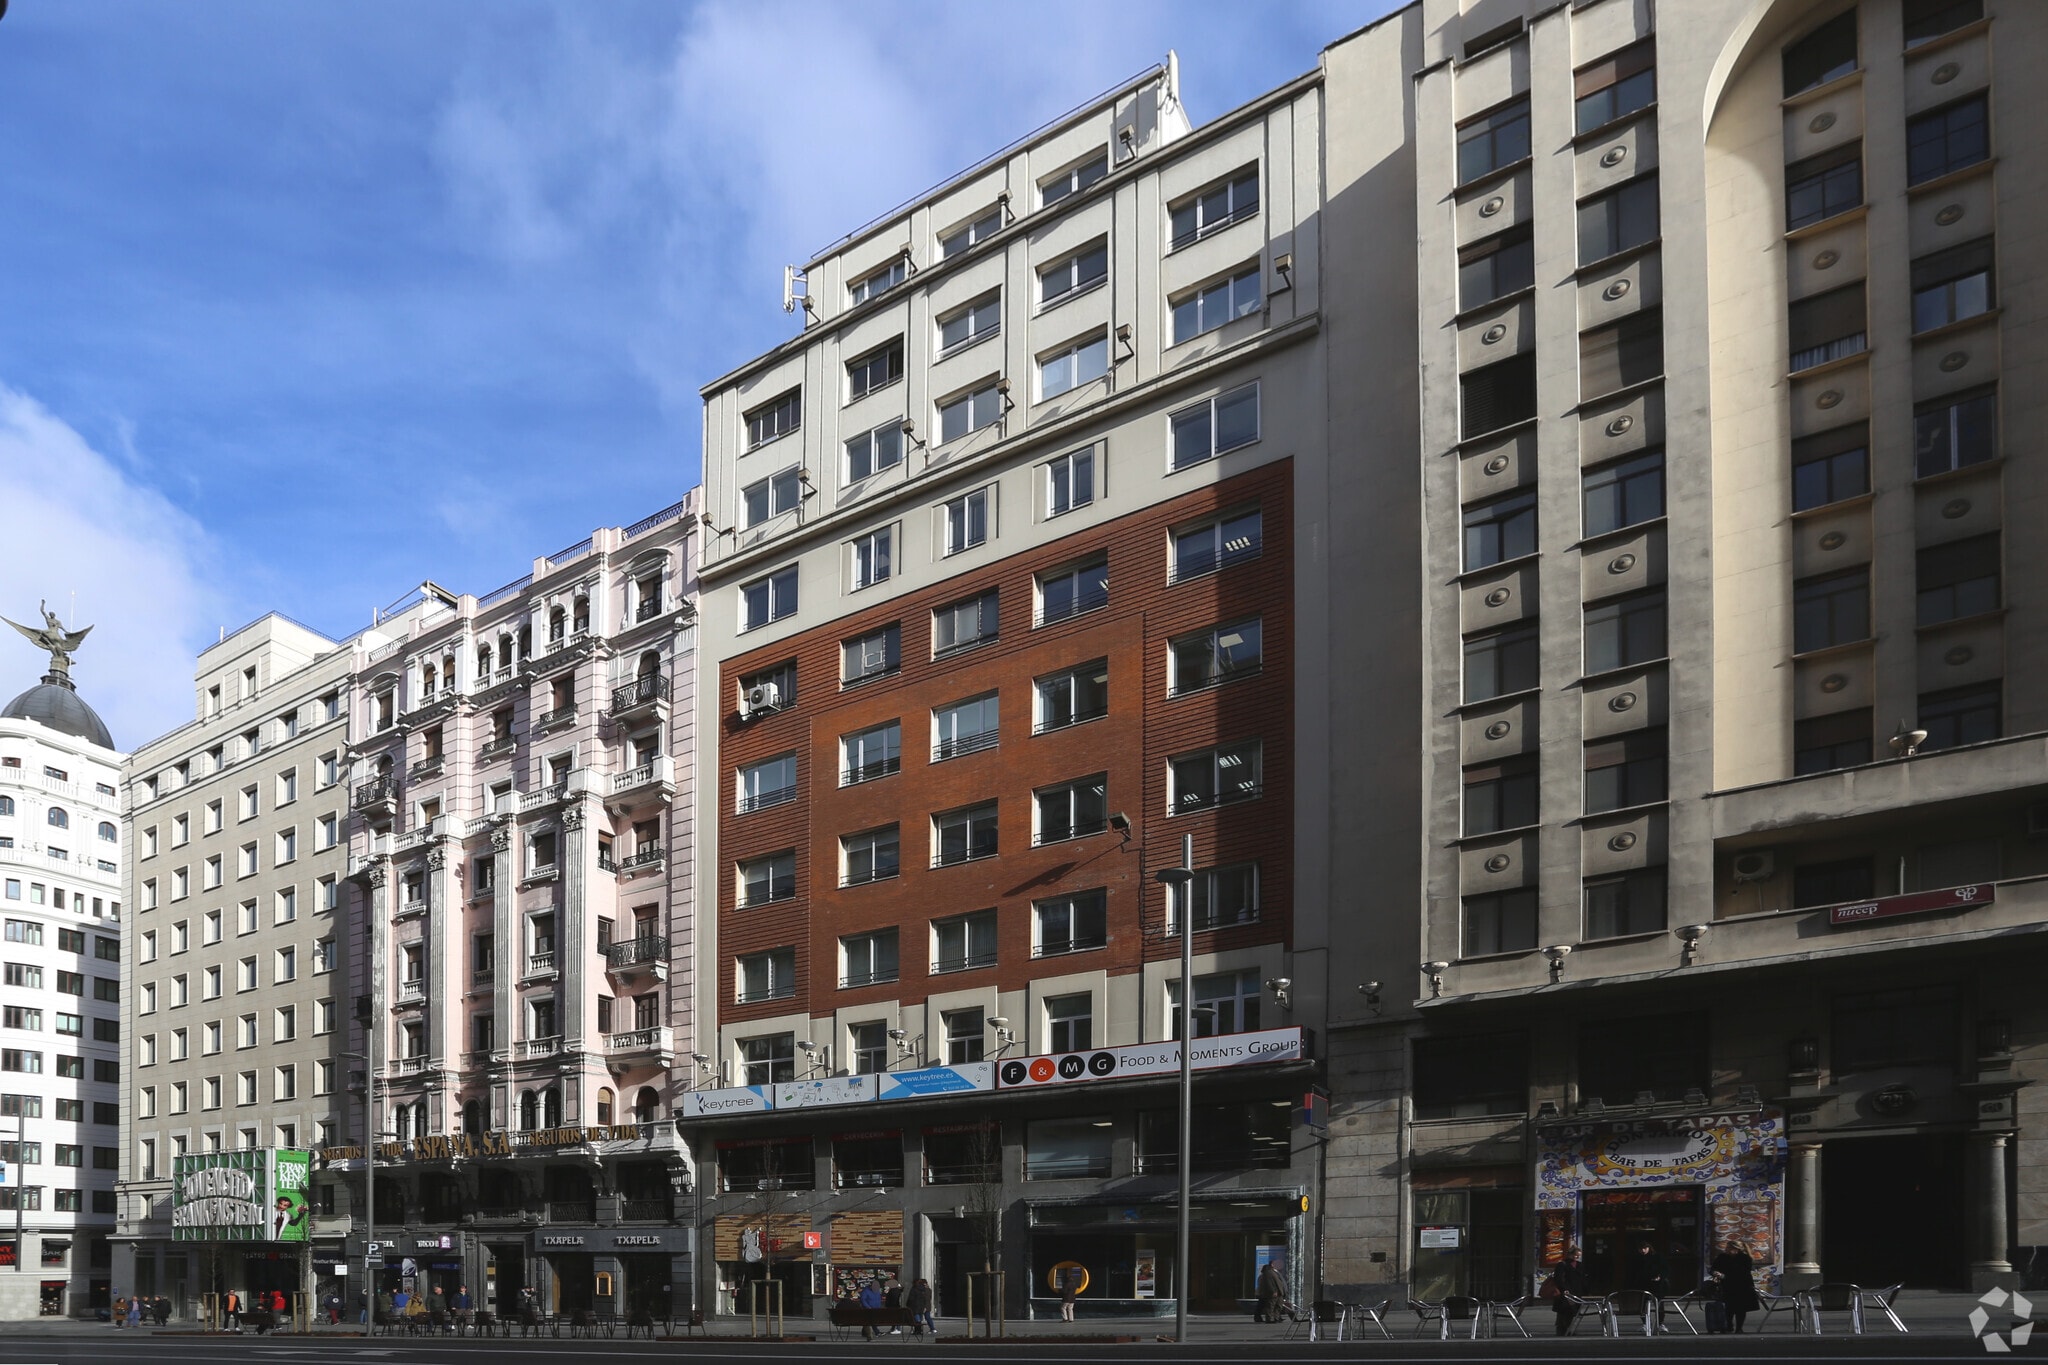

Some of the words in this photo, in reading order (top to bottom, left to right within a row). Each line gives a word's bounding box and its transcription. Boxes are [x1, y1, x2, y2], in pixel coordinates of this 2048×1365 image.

[1159, 1054, 1169, 1063] &
[1010, 1068, 1017, 1079] F
[1038, 1066, 1047, 1076] &
[1065, 1061, 1079, 1073] M
[1096, 1059, 1107, 1070] G
[901, 1072, 954, 1083] www.keytree.es
[703, 1098, 754, 1110] keytree
[1612, 1122, 1645, 1133] DE
[1662, 1114, 1751, 1130] TAPAS
[529, 1128, 580, 1146] SEGUROS
[608, 1124, 639, 1140] VIDA
[322, 1146, 361, 1161] SEGUROS
[1609, 1153, 1636, 1167] BAR
[1644, 1159, 1662, 1168] DE
[1672, 1147, 1712, 1166] TAPAS
[544, 1236, 584, 1245] TXAPELA
[616, 1235, 661, 1245] TXAPELA
[368, 1243, 379, 1255] P
